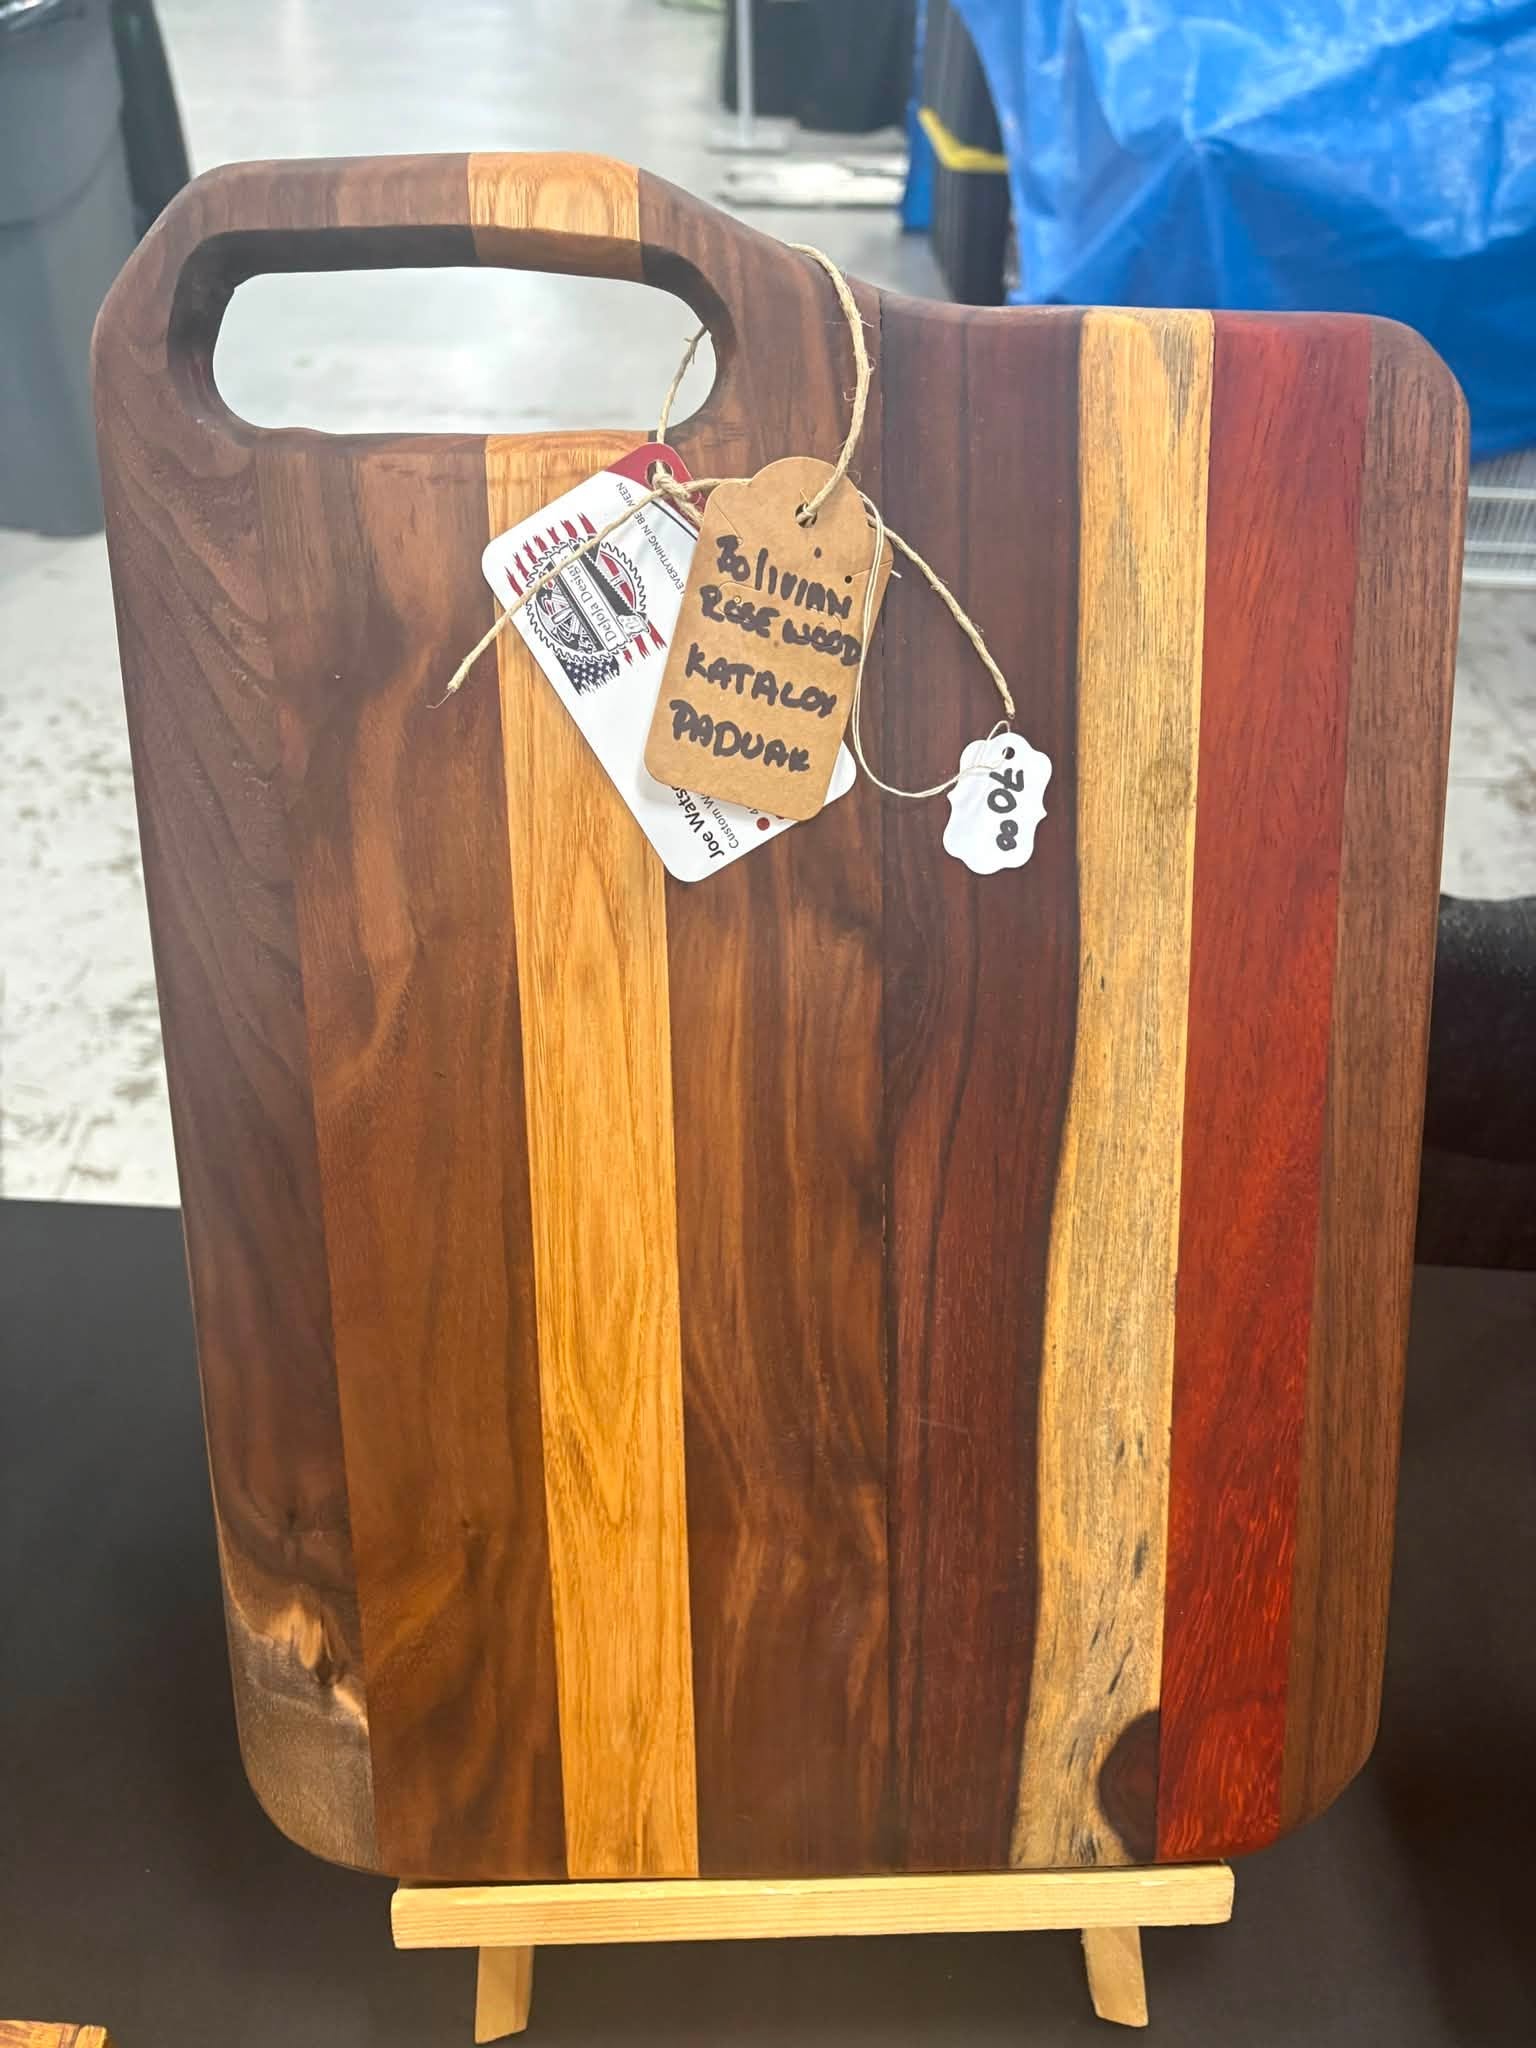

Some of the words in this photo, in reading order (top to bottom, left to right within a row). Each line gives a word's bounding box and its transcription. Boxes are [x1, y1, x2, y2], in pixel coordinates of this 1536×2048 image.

[641, 524, 651, 536] IN
[648, 535, 685, 590] EVERYTHING
[702, 831, 725, 858] Joe
[712, 808, 740, 849] Custom
